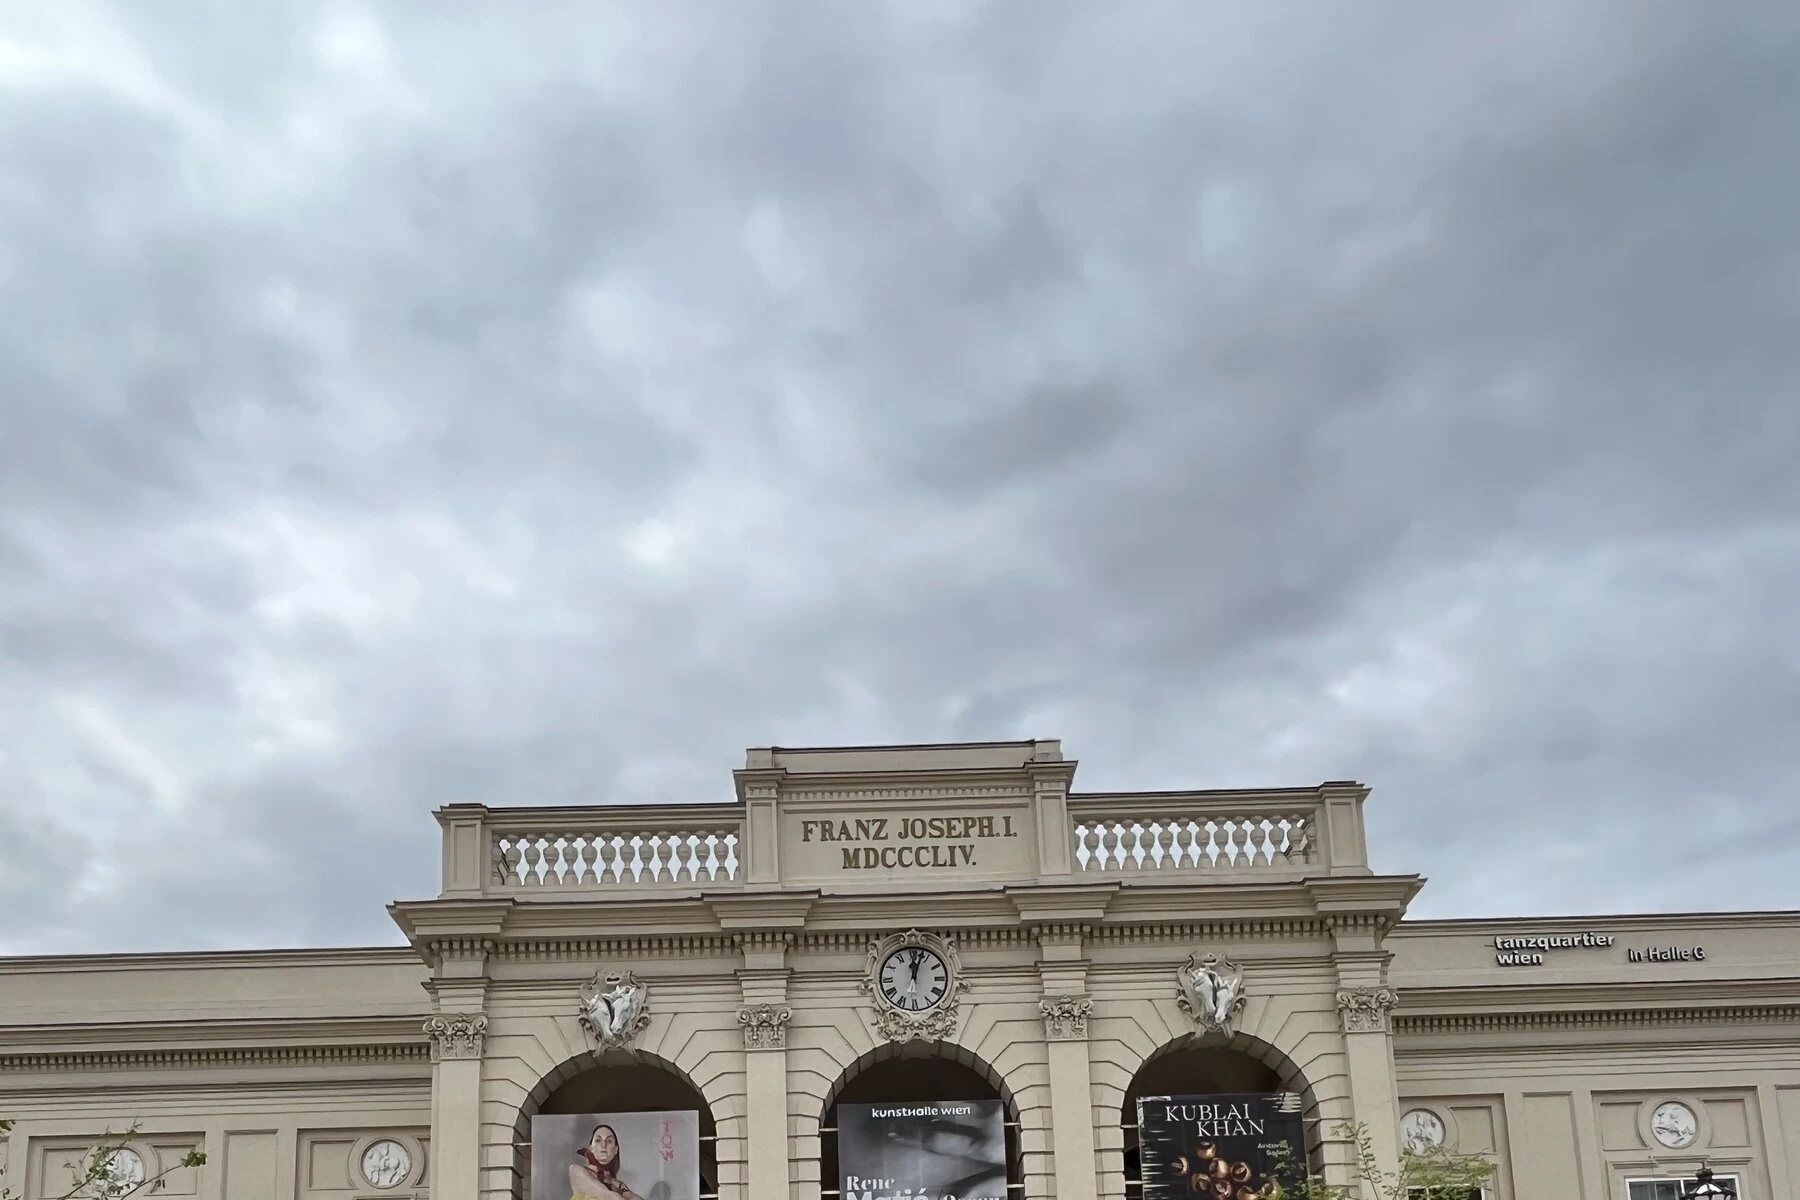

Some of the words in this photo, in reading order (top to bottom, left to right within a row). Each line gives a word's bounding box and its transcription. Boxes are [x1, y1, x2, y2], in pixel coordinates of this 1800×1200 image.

[801, 818, 888, 842] FRANZ
[841, 844, 977, 869] MDCCCLIV.
[1494, 931, 1616, 952] tanzquartier
[1496, 950, 1543, 967] wien
[1647, 946, 1691, 963] Halle
[1692, 945, 1706, 961] G
[940, 1106, 971, 1116] wien
[1165, 1103, 1250, 1122] KUBLAI
[1196, 1119, 1264, 1137] KHAN
